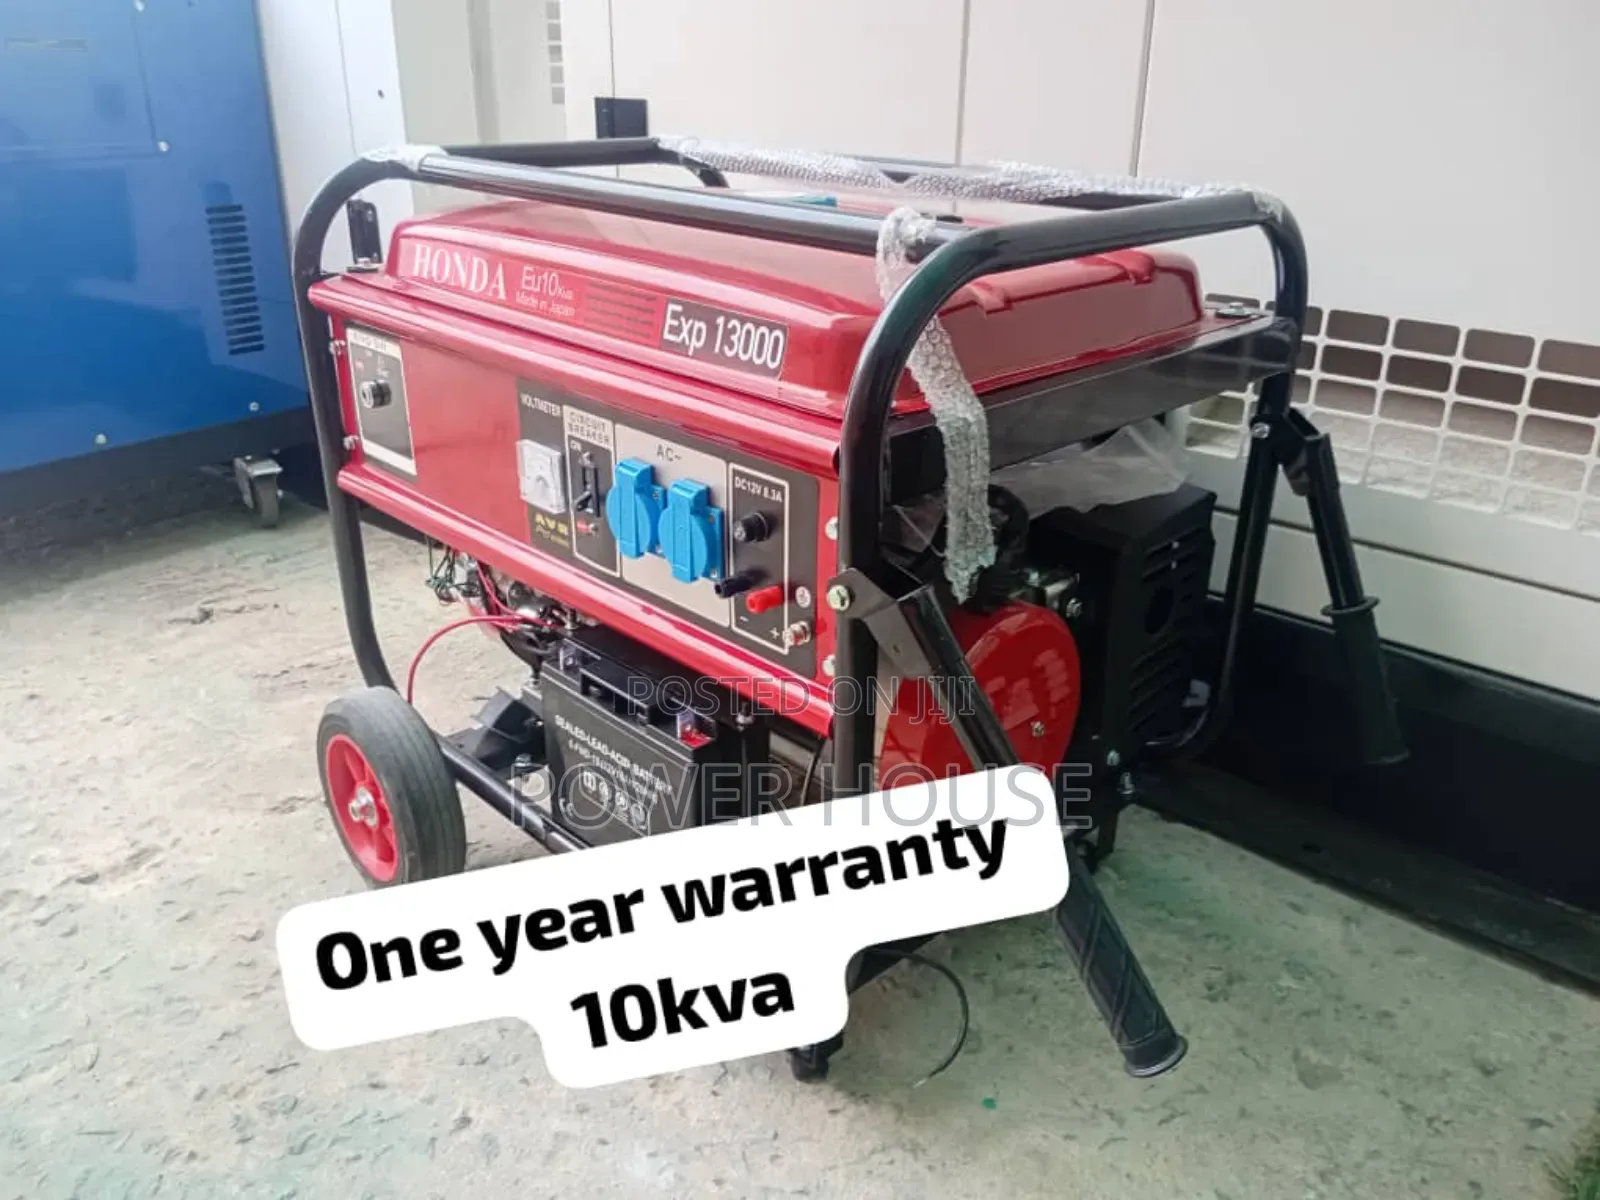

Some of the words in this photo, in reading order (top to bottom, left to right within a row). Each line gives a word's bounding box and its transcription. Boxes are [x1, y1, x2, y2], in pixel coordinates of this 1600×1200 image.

[411, 243, 507, 300] HONDA
[662, 304, 706, 356] Exp
[714, 315, 785, 370] 13000
[520, 392, 562, 417] VOLTMETER
[568, 410, 607, 432] CIRCUIT
[567, 422, 610, 446] BREAKER
[734, 476, 762, 495] DC12V
